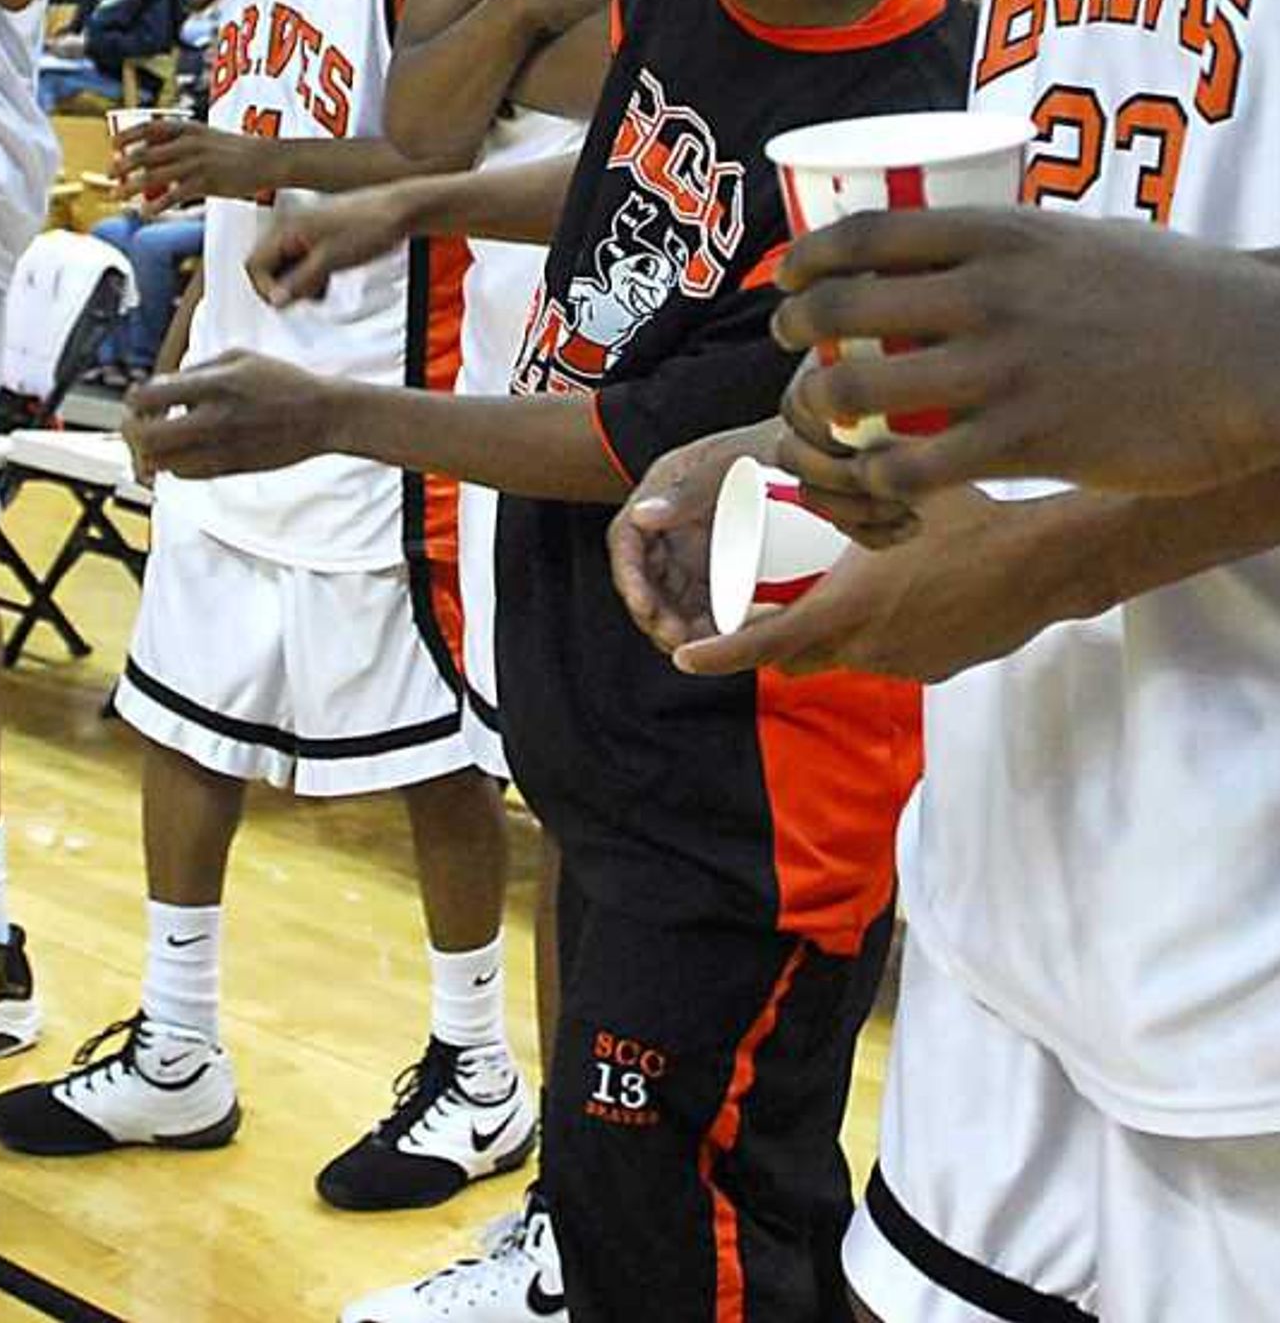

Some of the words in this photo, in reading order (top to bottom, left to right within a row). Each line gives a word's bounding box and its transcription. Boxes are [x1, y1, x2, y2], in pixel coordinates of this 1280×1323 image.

[606, 67, 746, 299] SCC
[1016, 84, 1189, 228] 23
[592, 1062, 647, 1109] 13
[594, 1030, 665, 1078] SCC
